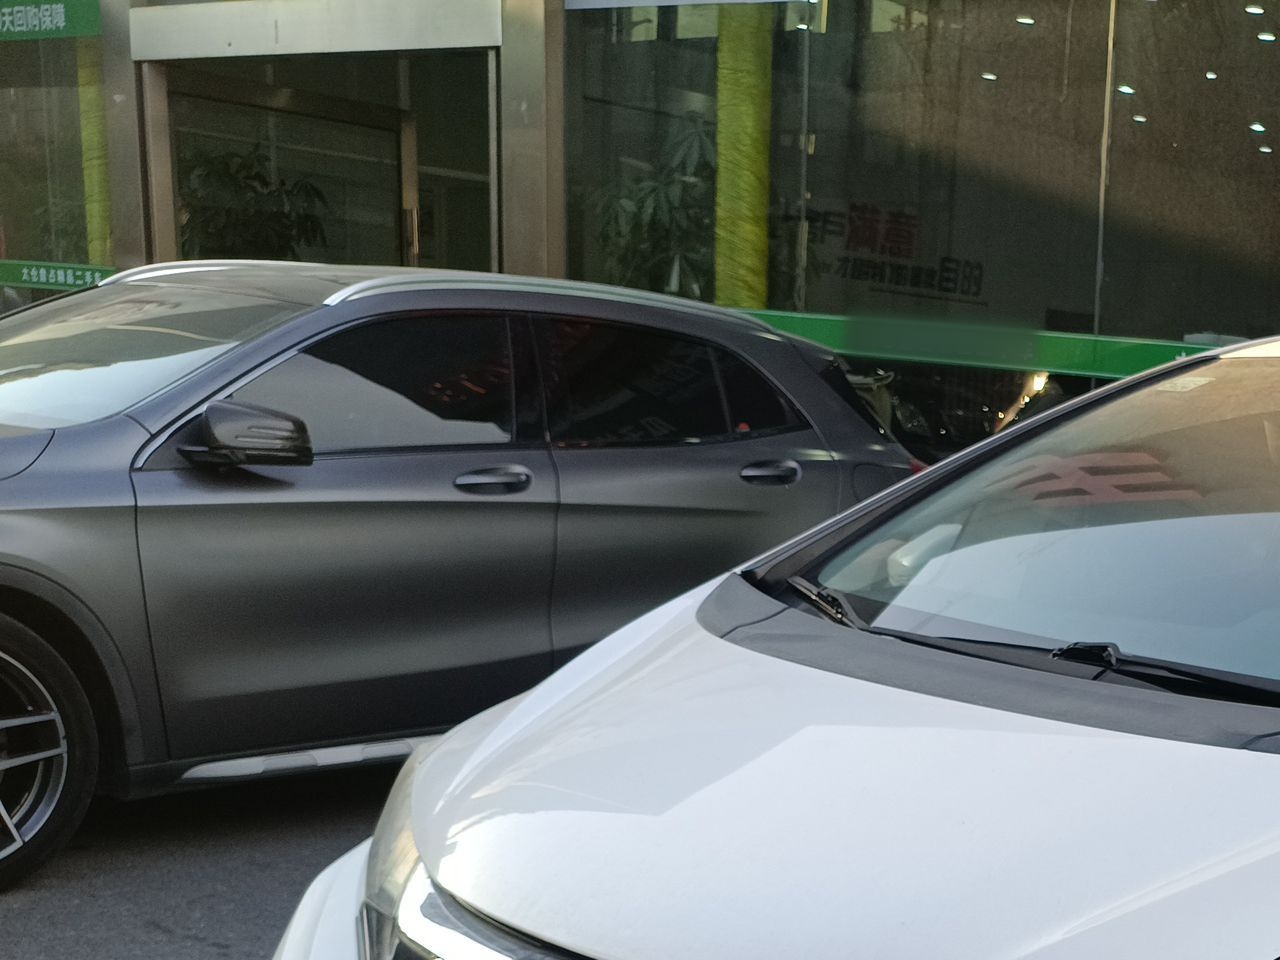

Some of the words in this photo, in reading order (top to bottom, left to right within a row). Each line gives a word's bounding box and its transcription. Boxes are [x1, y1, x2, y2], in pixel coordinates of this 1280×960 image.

[0, 3, 66, 32] 天回购保障
